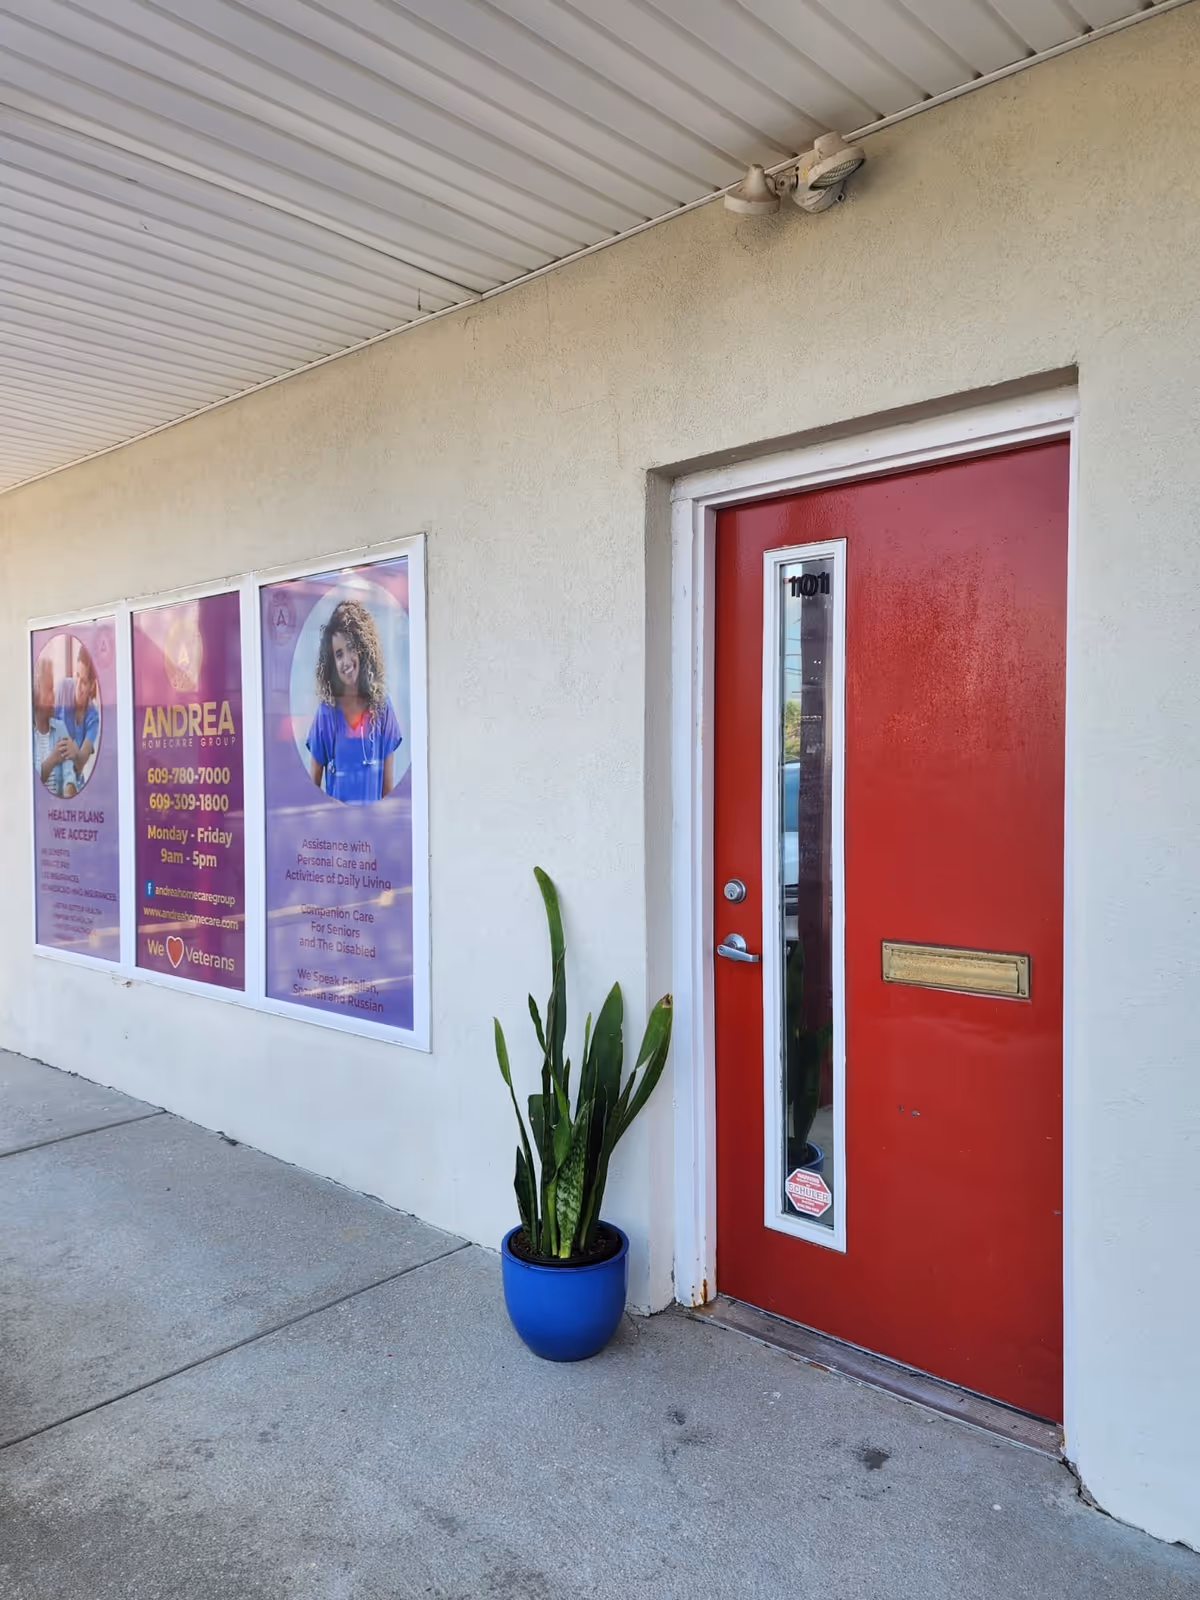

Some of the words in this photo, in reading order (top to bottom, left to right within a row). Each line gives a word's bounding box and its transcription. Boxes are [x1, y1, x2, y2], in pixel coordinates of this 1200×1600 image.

[142, 700, 236, 739] ANDREA
[142, 738, 193, 749] HOMECARE
[200, 736, 236, 747] GROUP
[147, 767, 230, 784] 609-780-7000
[149, 793, 229, 811] 609-309-1800
[48, 809, 76, 822] HEALTH
[78, 811, 104, 823] PLANS
[53, 828, 66, 839] WE
[68, 829, 98, 842] ACCEPT
[147, 825, 189, 845] Monday
[197, 826, 233, 848] Friday
[302, 838, 349, 852] Assistance
[350, 840, 371, 853] with
[160, 848, 183, 864] 9am
[192, 851, 217, 869] 5pm
[297, 854, 334, 867] Personal
[336, 857, 357, 870] Care
[359, 859, 377, 871] and
[285, 870, 325, 884] Activities
[326, 873, 336, 884] of
[337, 873, 360, 889] Daily
[362, 876, 391, 893] Living
[155, 885, 236, 907] andreahomecaregroup
[143, 906, 239, 930] www.andreahomecare.com
[300, 904, 350, 921] Companion
[352, 909, 374, 923] Care
[311, 921, 326, 933] For
[327, 923, 361, 938] Seniors
[147, 939, 165, 956] We
[185, 946, 235, 971] Veterans
[299, 937, 316, 949] and
[317, 938, 334, 952] The
[336, 941, 376, 958] Disabled
[297, 968, 312, 980] We
[313, 969, 339, 986] Speak
[328, 991, 346, 1004] and
[347, 995, 384, 1013] Russian
[788, 1183, 828, 1201] SCHULER
